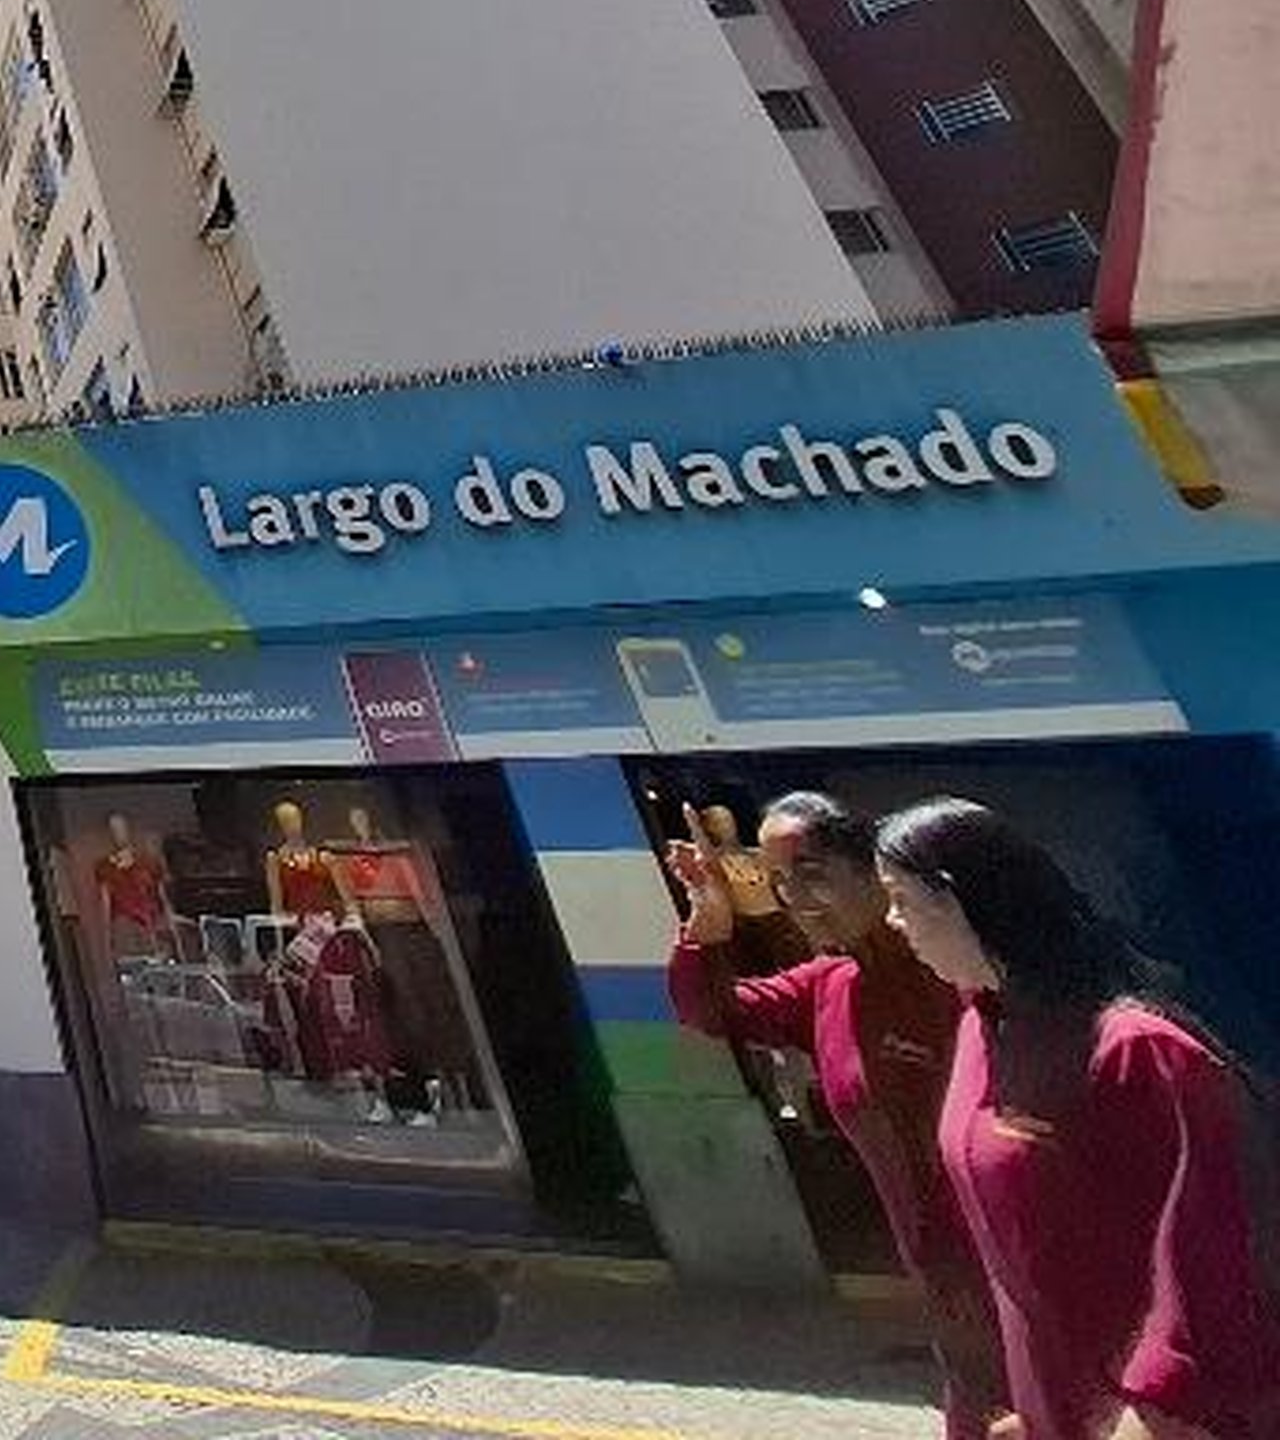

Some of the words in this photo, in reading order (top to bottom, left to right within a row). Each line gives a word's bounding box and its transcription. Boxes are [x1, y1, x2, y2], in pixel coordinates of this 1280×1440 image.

[198, 481, 432, 554] Largo
[453, 455, 566, 527] do
[585, 408, 1058, 515] Machado
